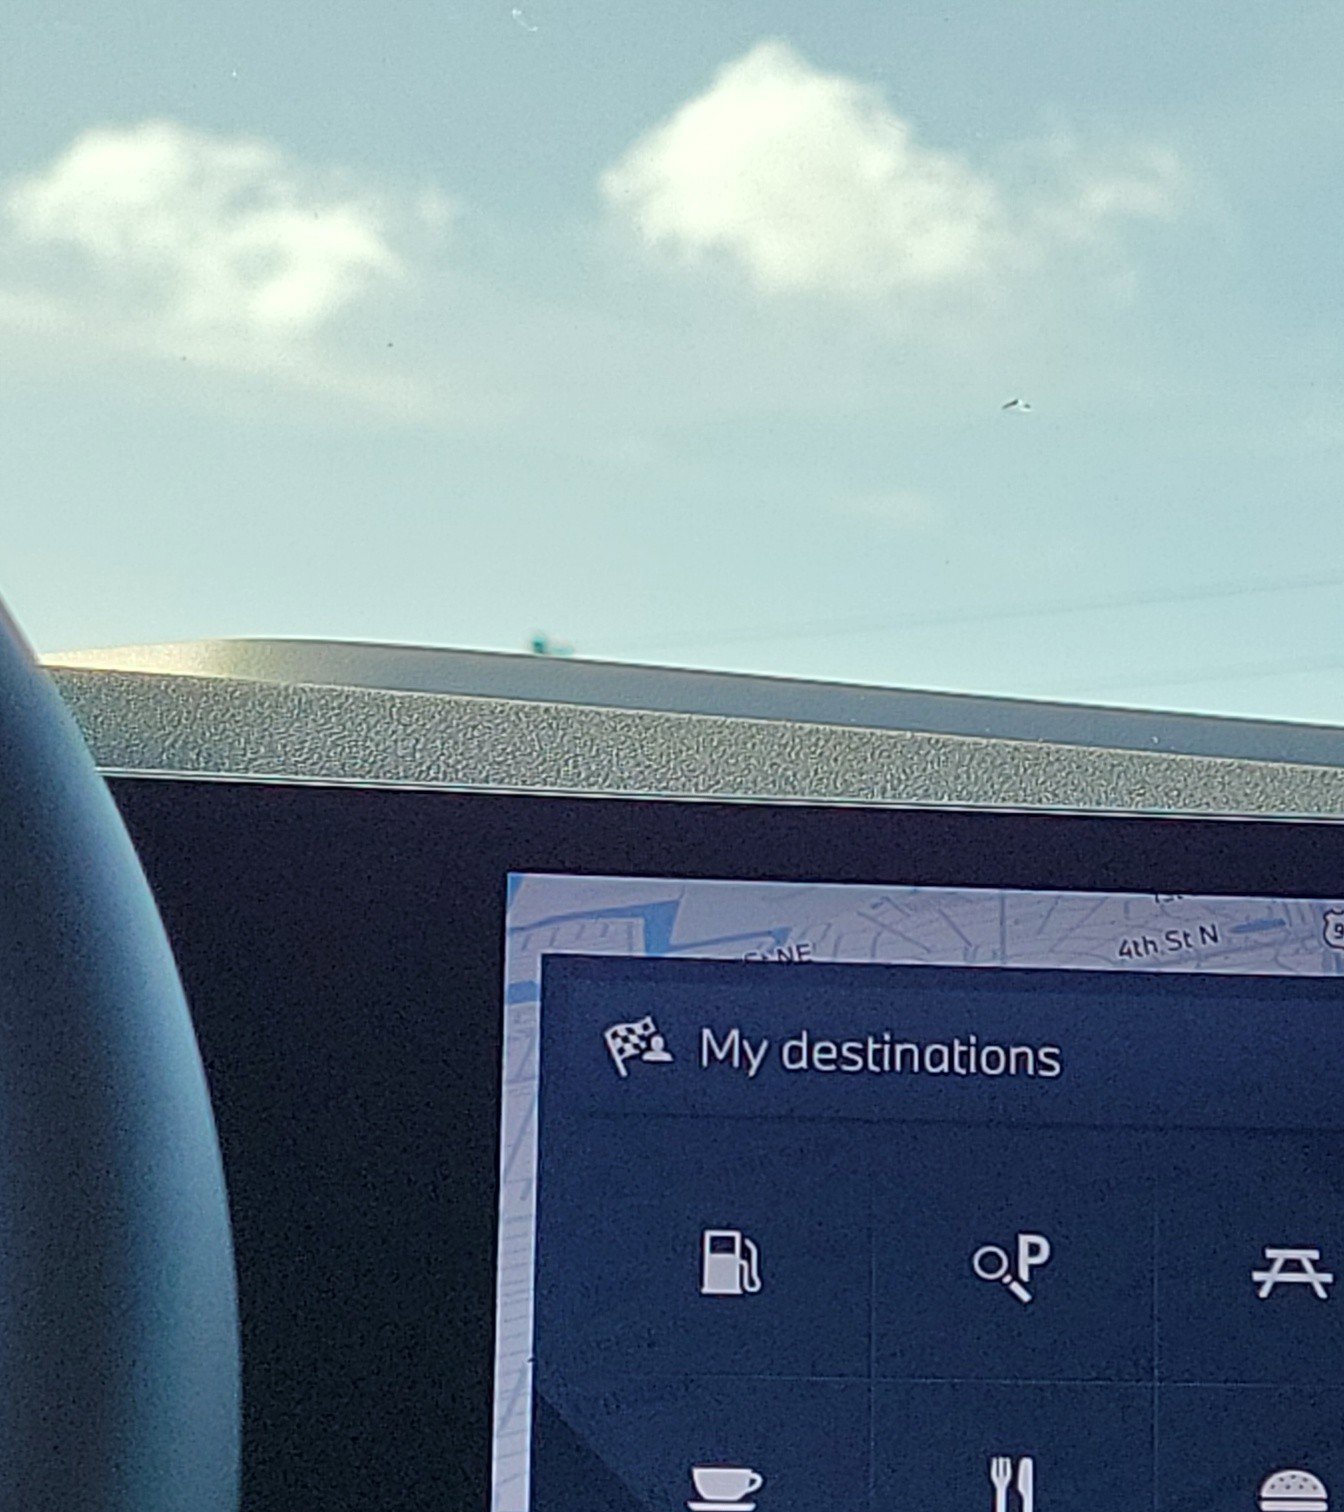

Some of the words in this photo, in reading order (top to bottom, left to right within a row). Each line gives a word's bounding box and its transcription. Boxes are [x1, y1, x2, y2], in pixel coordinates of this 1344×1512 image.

[1118, 935, 1159, 959] 4th
[1165, 929, 1193, 951] St
[1200, 924, 1218, 945] N
[699, 1026, 768, 1076] My
[781, 1032, 1063, 1081] destinations
